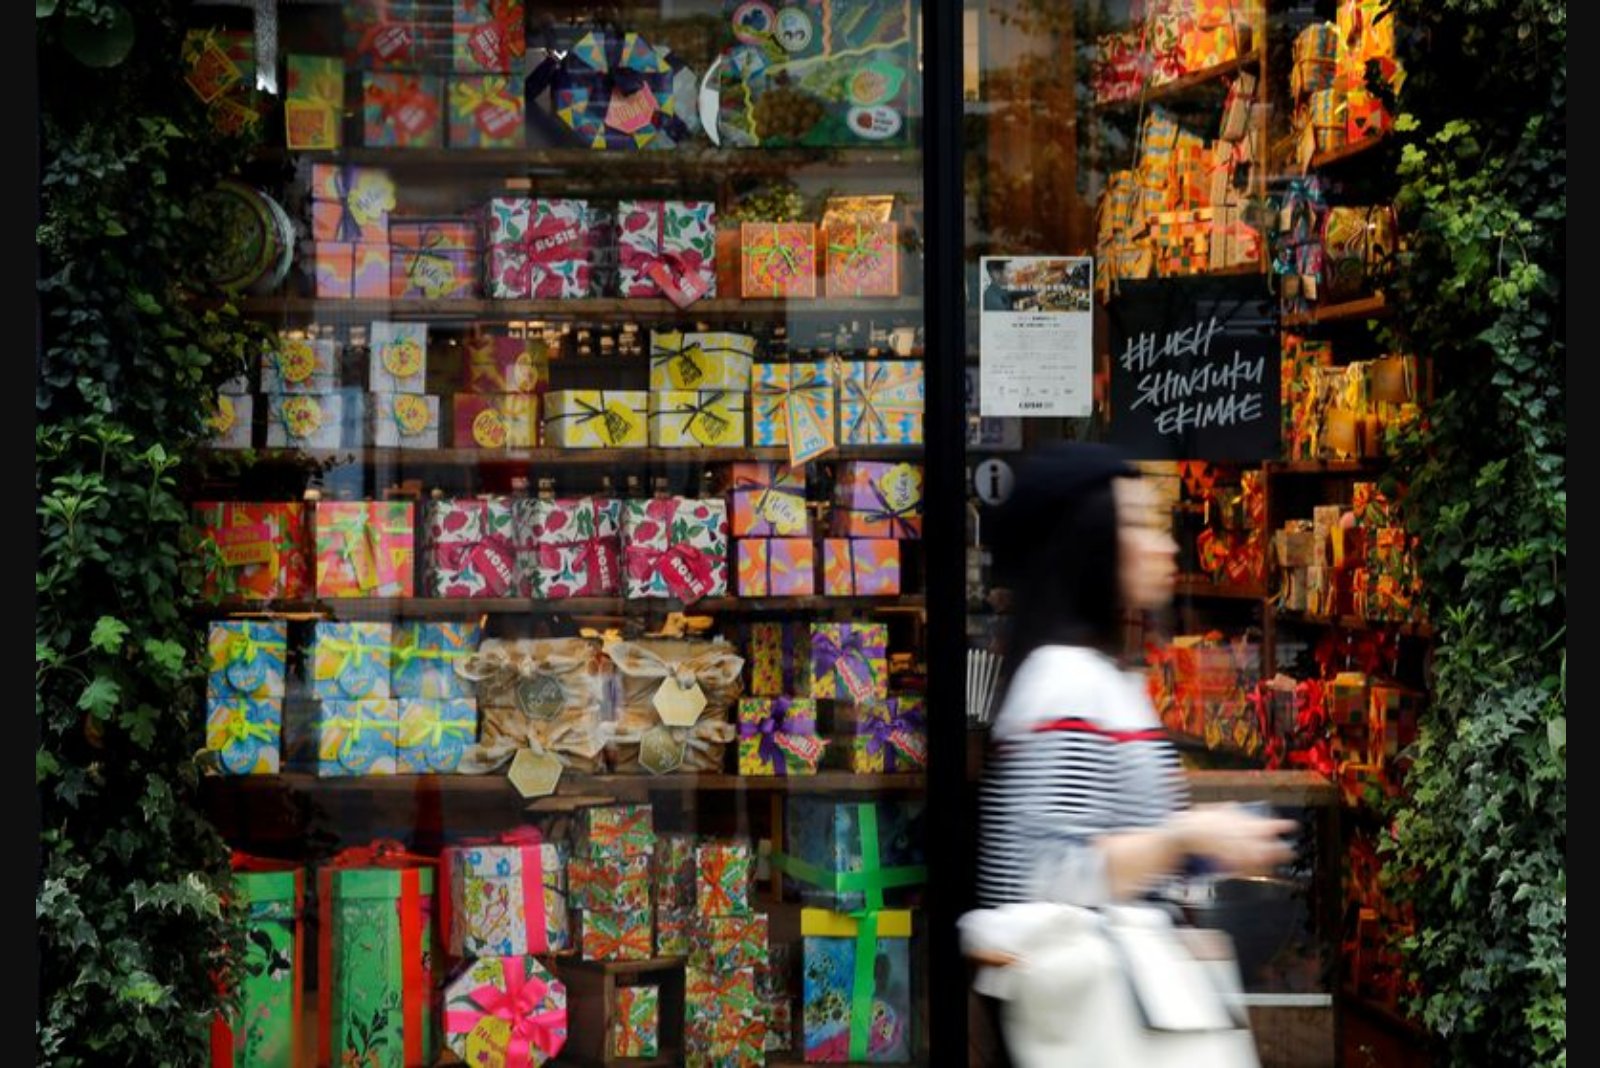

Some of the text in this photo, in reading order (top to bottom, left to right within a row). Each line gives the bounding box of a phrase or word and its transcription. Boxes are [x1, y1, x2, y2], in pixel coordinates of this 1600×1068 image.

[536, 228, 578, 252] ROSIE
[1120, 316, 1225, 372] #LUSH
[1130, 350, 1265, 411] SHINJUKU
[1154, 393, 1262, 434] EKIMAE
[671, 556, 704, 596] ROSIE
